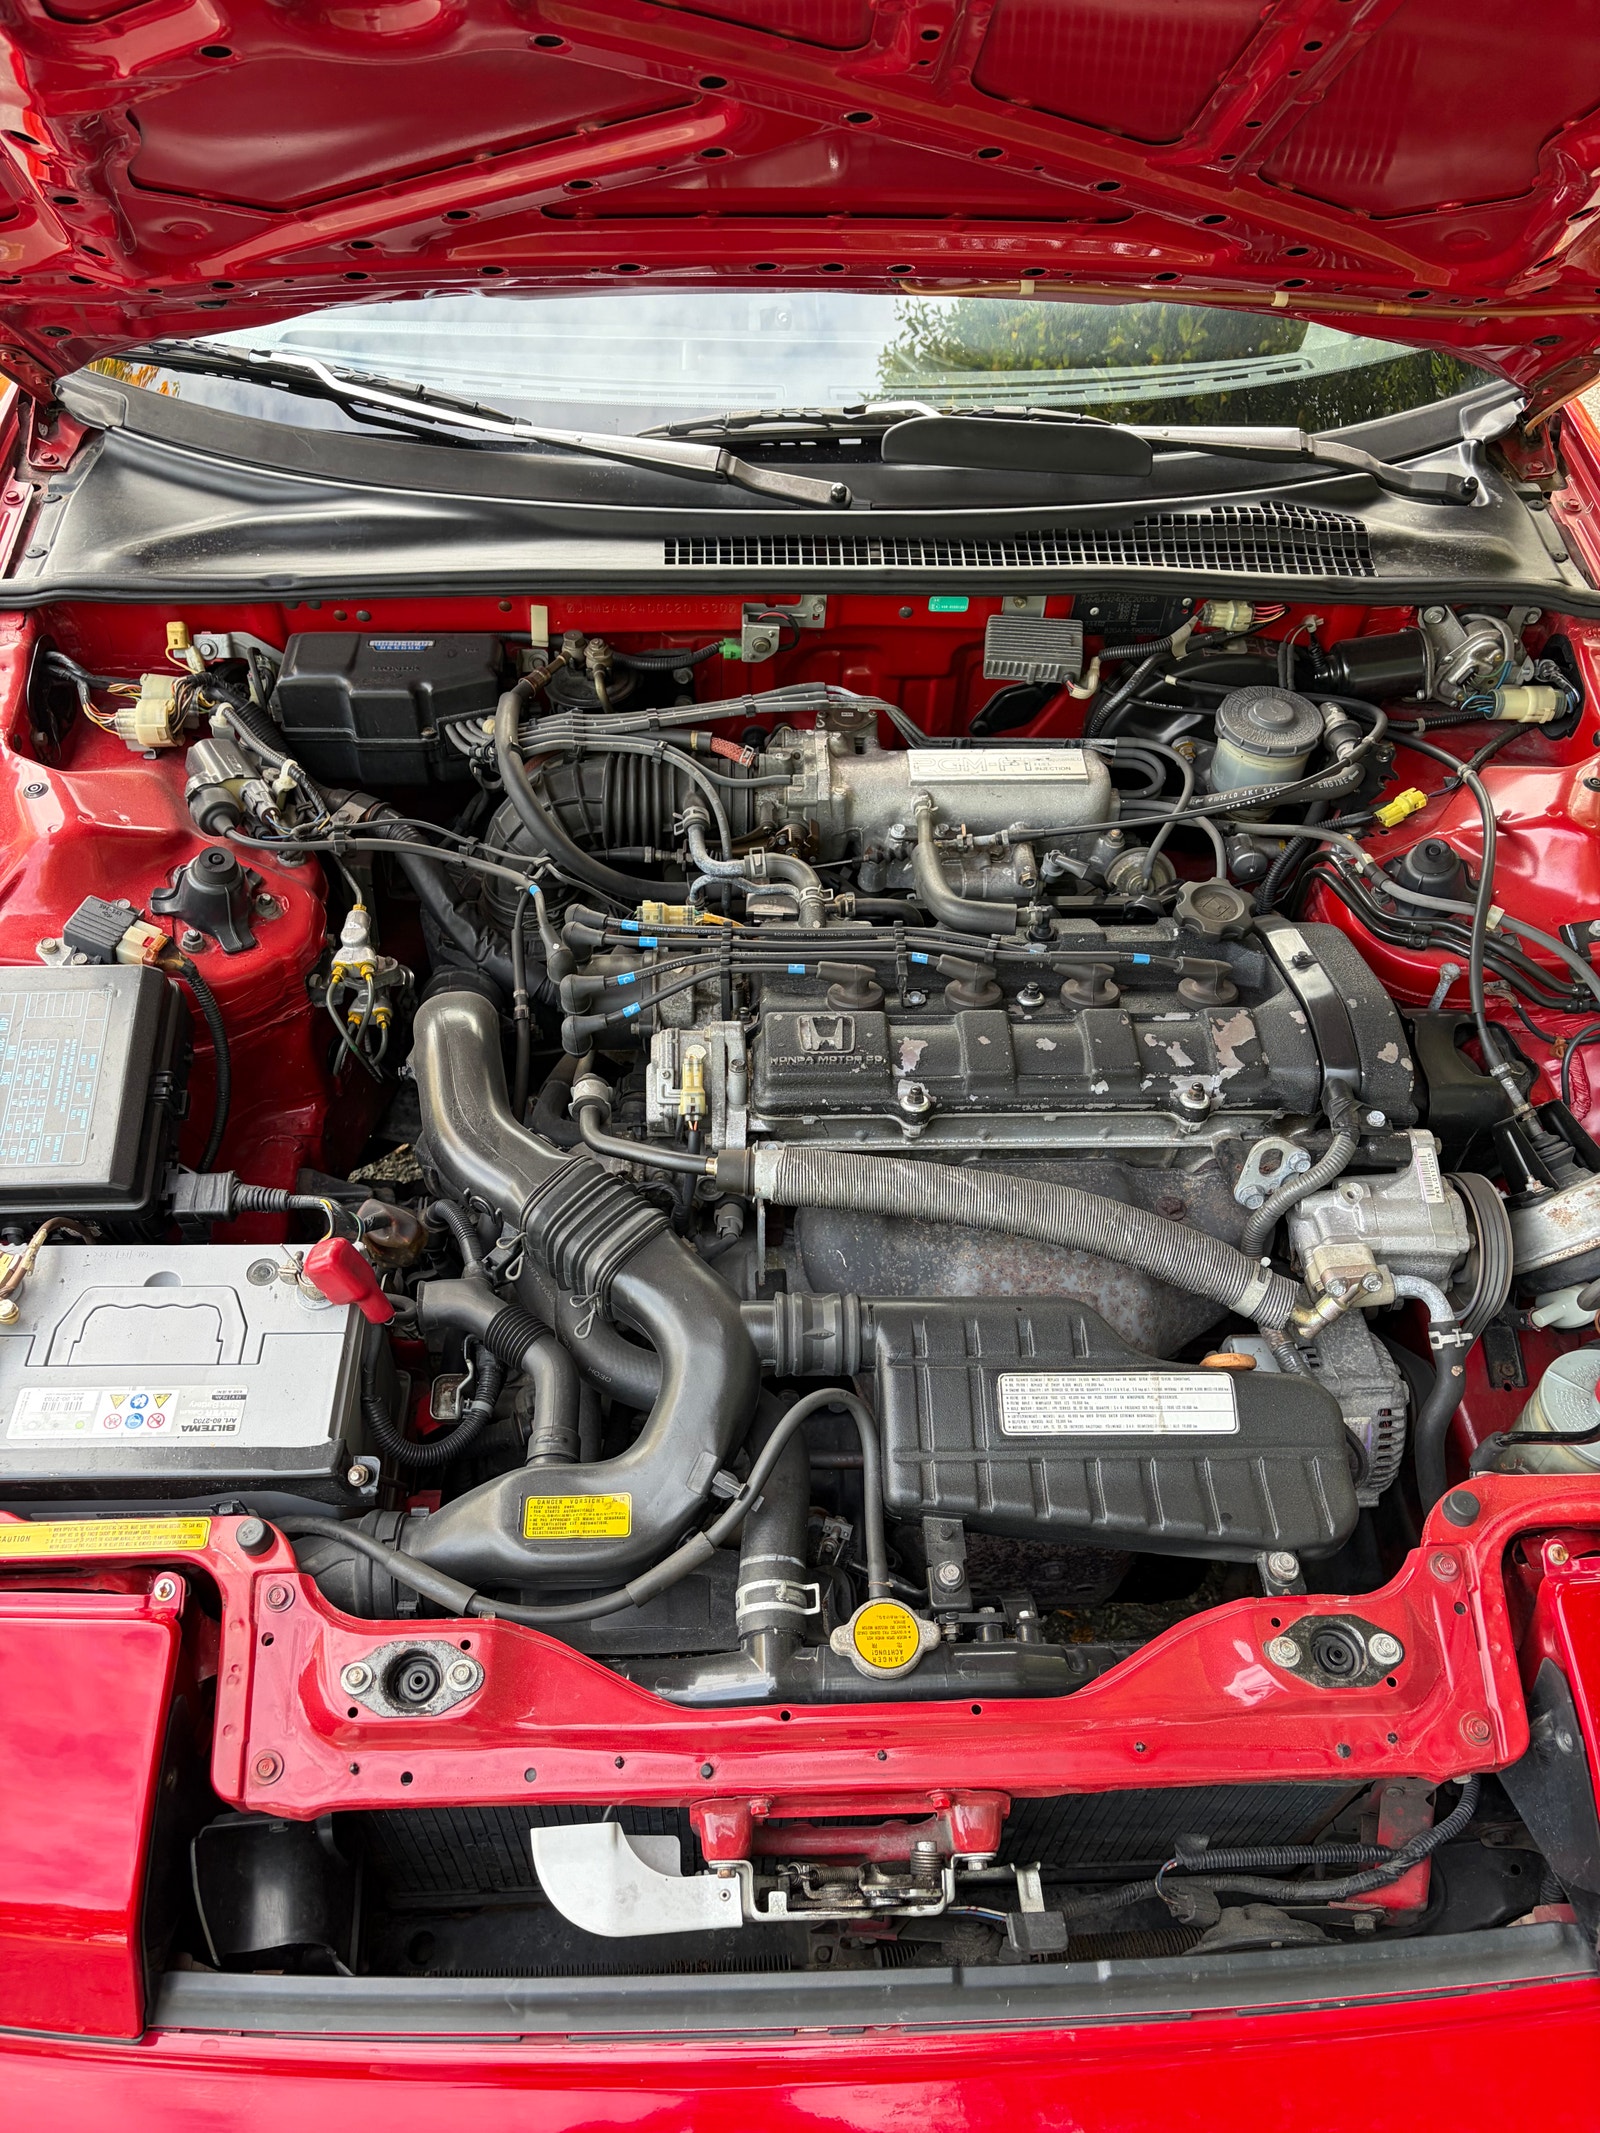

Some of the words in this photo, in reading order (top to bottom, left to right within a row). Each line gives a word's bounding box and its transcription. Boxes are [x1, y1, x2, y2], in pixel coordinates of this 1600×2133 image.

[1318, 777, 1349, 789] ENGINE
[5, 1045, 17, 1060] MAIN
[770, 1056, 814, 1064] HONDA
[818, 1055, 862, 1065] MOTOR
[0, 1071, 12, 1085] FUSE
[180, 1424, 236, 1432] BILTEMA
